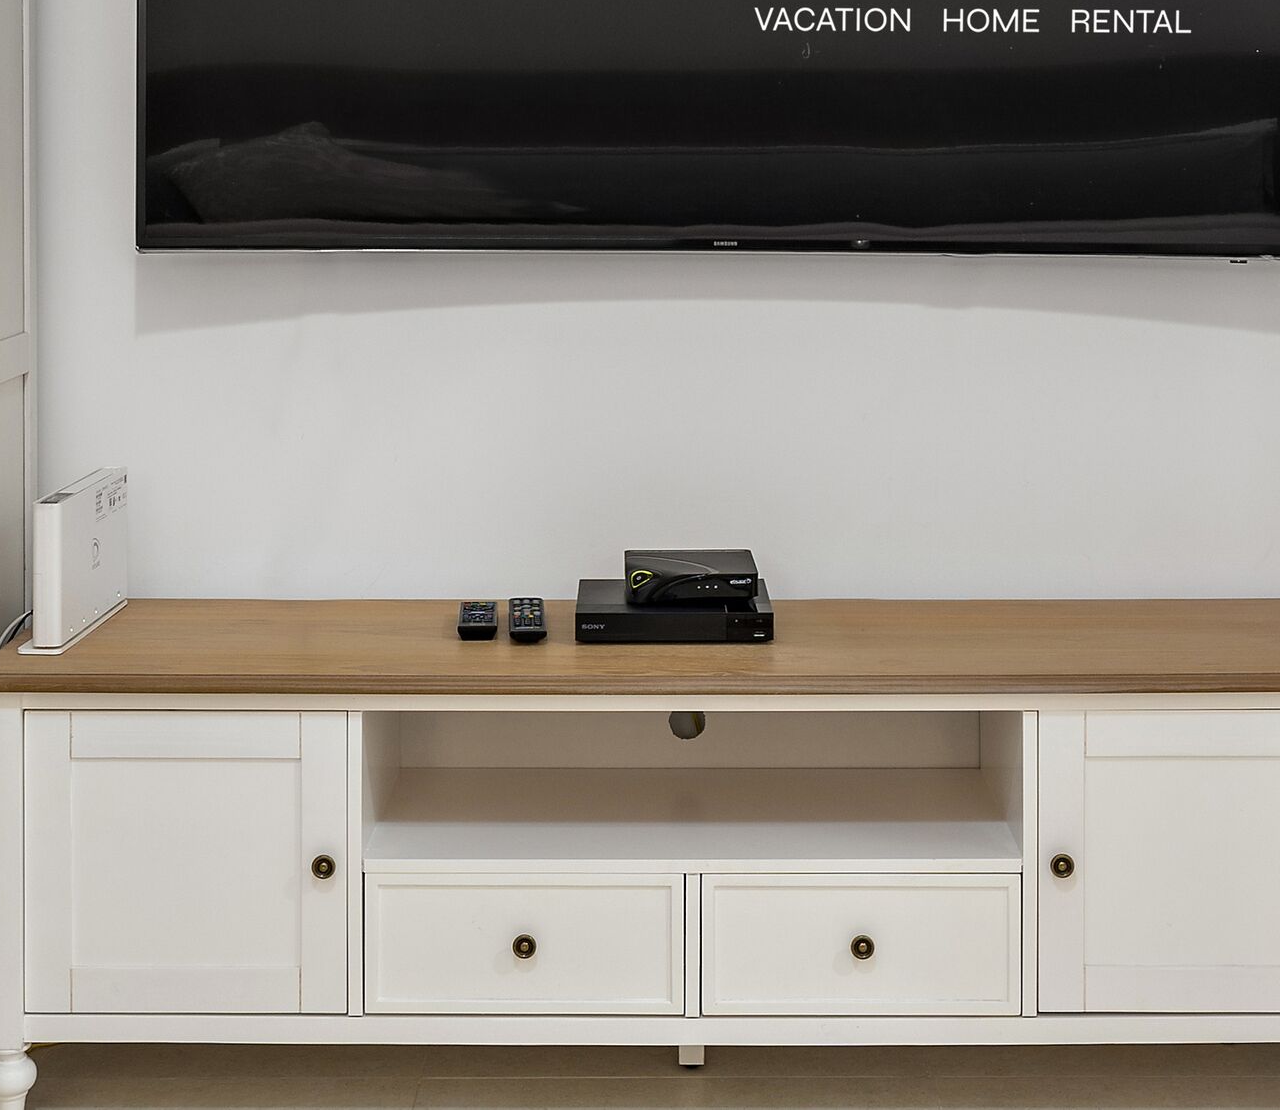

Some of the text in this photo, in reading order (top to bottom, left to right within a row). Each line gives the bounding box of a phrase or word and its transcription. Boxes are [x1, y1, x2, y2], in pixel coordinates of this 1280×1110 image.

[754, 7, 1192, 34] VACATION HOME RENTAL
